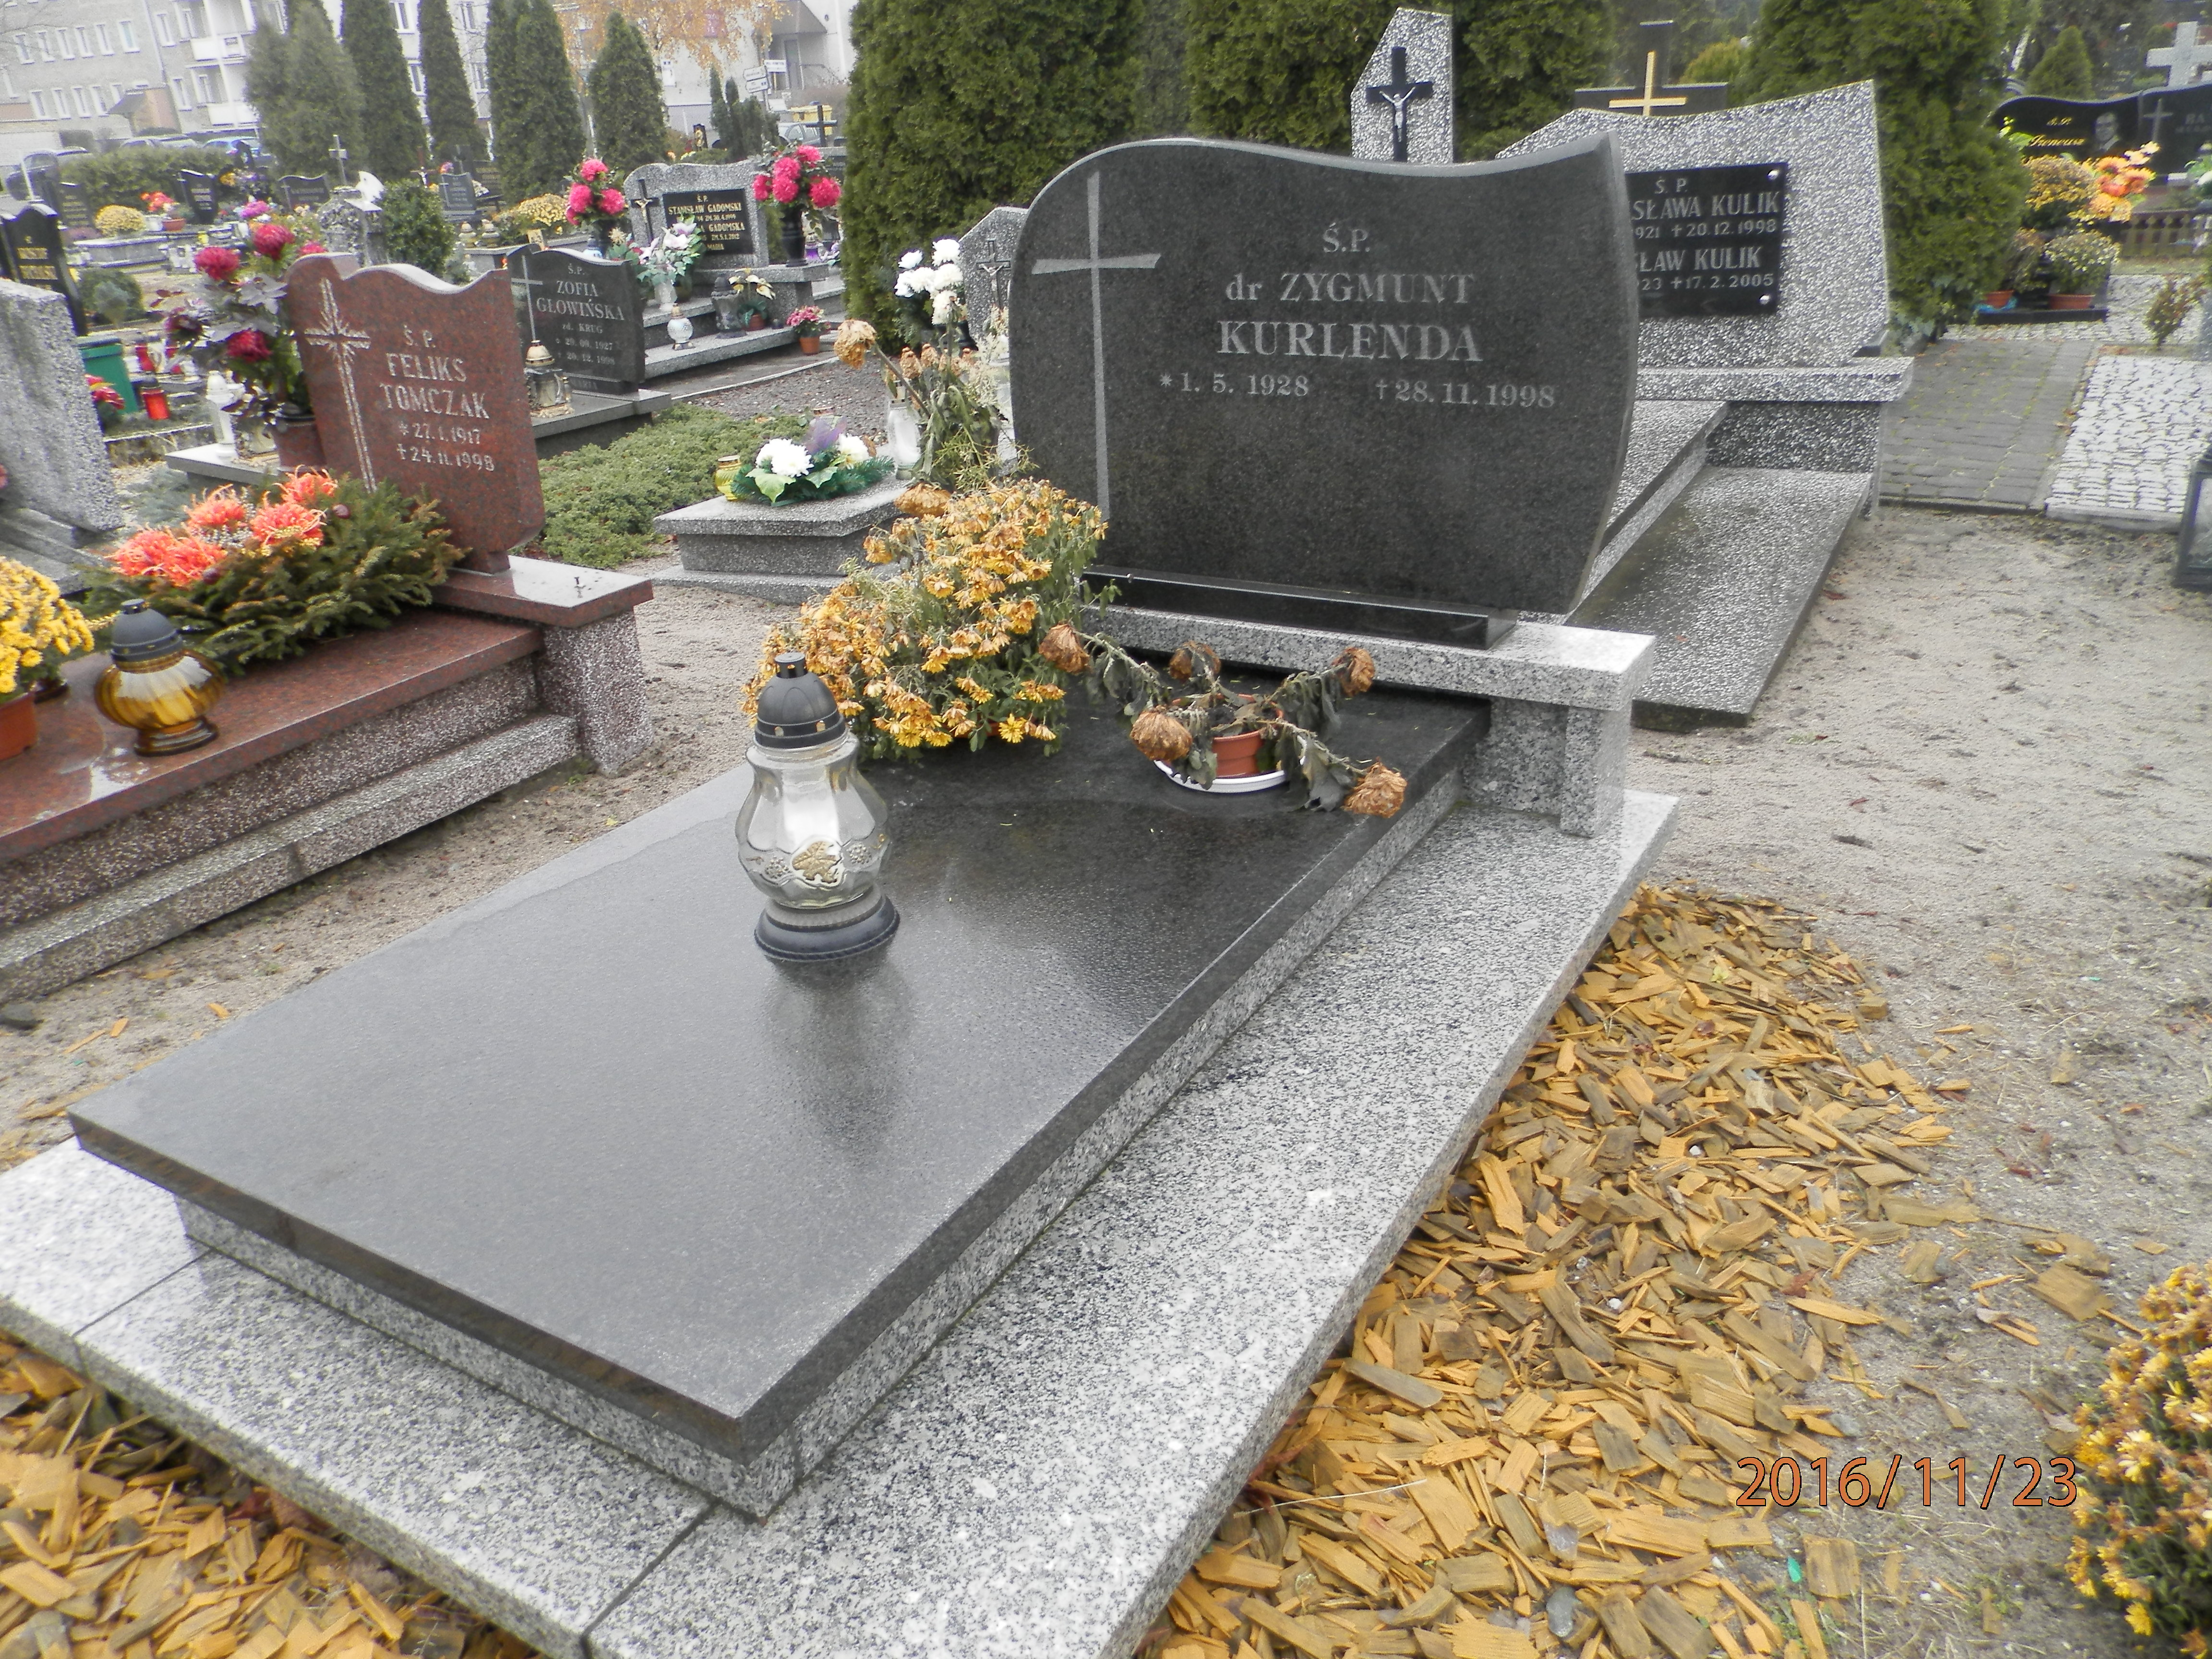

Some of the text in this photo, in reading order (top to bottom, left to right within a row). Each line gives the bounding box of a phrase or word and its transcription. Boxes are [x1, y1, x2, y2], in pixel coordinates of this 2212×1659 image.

[668, 202, 742, 215] STANISŁAW GADOMSKI
[1711, 192, 1779, 216] KULIK
[709, 222, 745, 232] GADOMSKA
[1635, 246, 1762, 272] ŁAW KULIK
[556, 280, 599, 297] ZOFIA
[1225, 272, 1475, 304] dr ZYGMUNT
[579, 323, 603, 334] KRUG
[1216, 320, 1484, 362] KURLENDA
[386, 352, 467, 382] FELIKS
[379, 383, 490, 419] TOMCZAK
[1248, 374, 1309, 397] 1928
[1486, 384, 1555, 408] 1998
